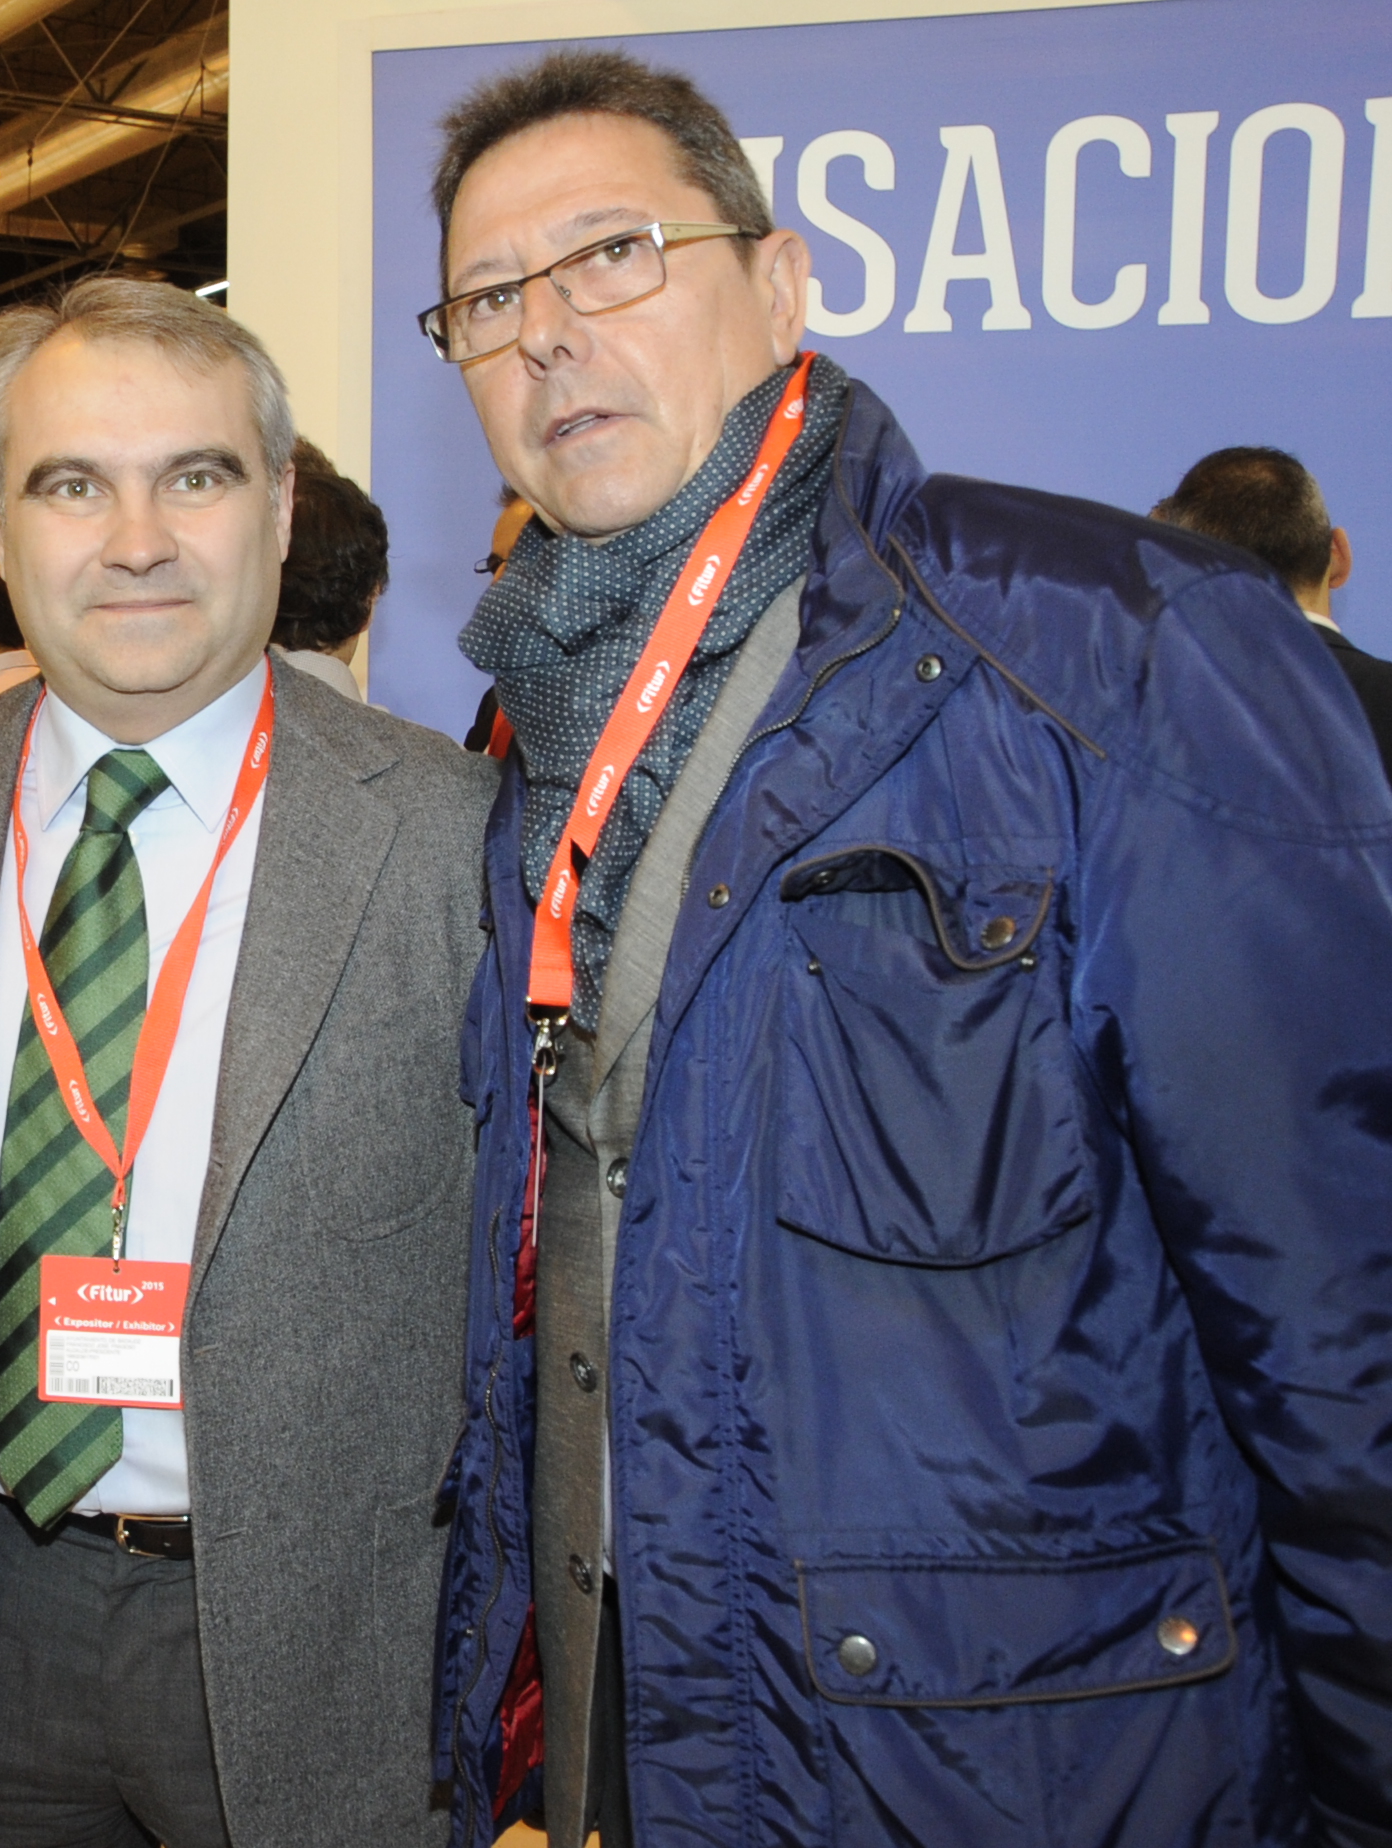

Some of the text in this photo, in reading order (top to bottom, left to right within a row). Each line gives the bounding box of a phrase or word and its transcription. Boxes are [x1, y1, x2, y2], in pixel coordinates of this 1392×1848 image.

[691, 562, 717, 598] Fitur
[640, 668, 667, 705] Fitur
[588, 772, 610, 809] Fitur
[550, 876, 569, 913] Fitur
[39, 1000, 56, 1029] Fitur
[71, 1086, 88, 1117] Fitur
[89, 1280, 165, 1302] Fitur 2015
[63, 1317, 114, 1330] Expositor
[123, 1320, 167, 1332] Exhibitor
